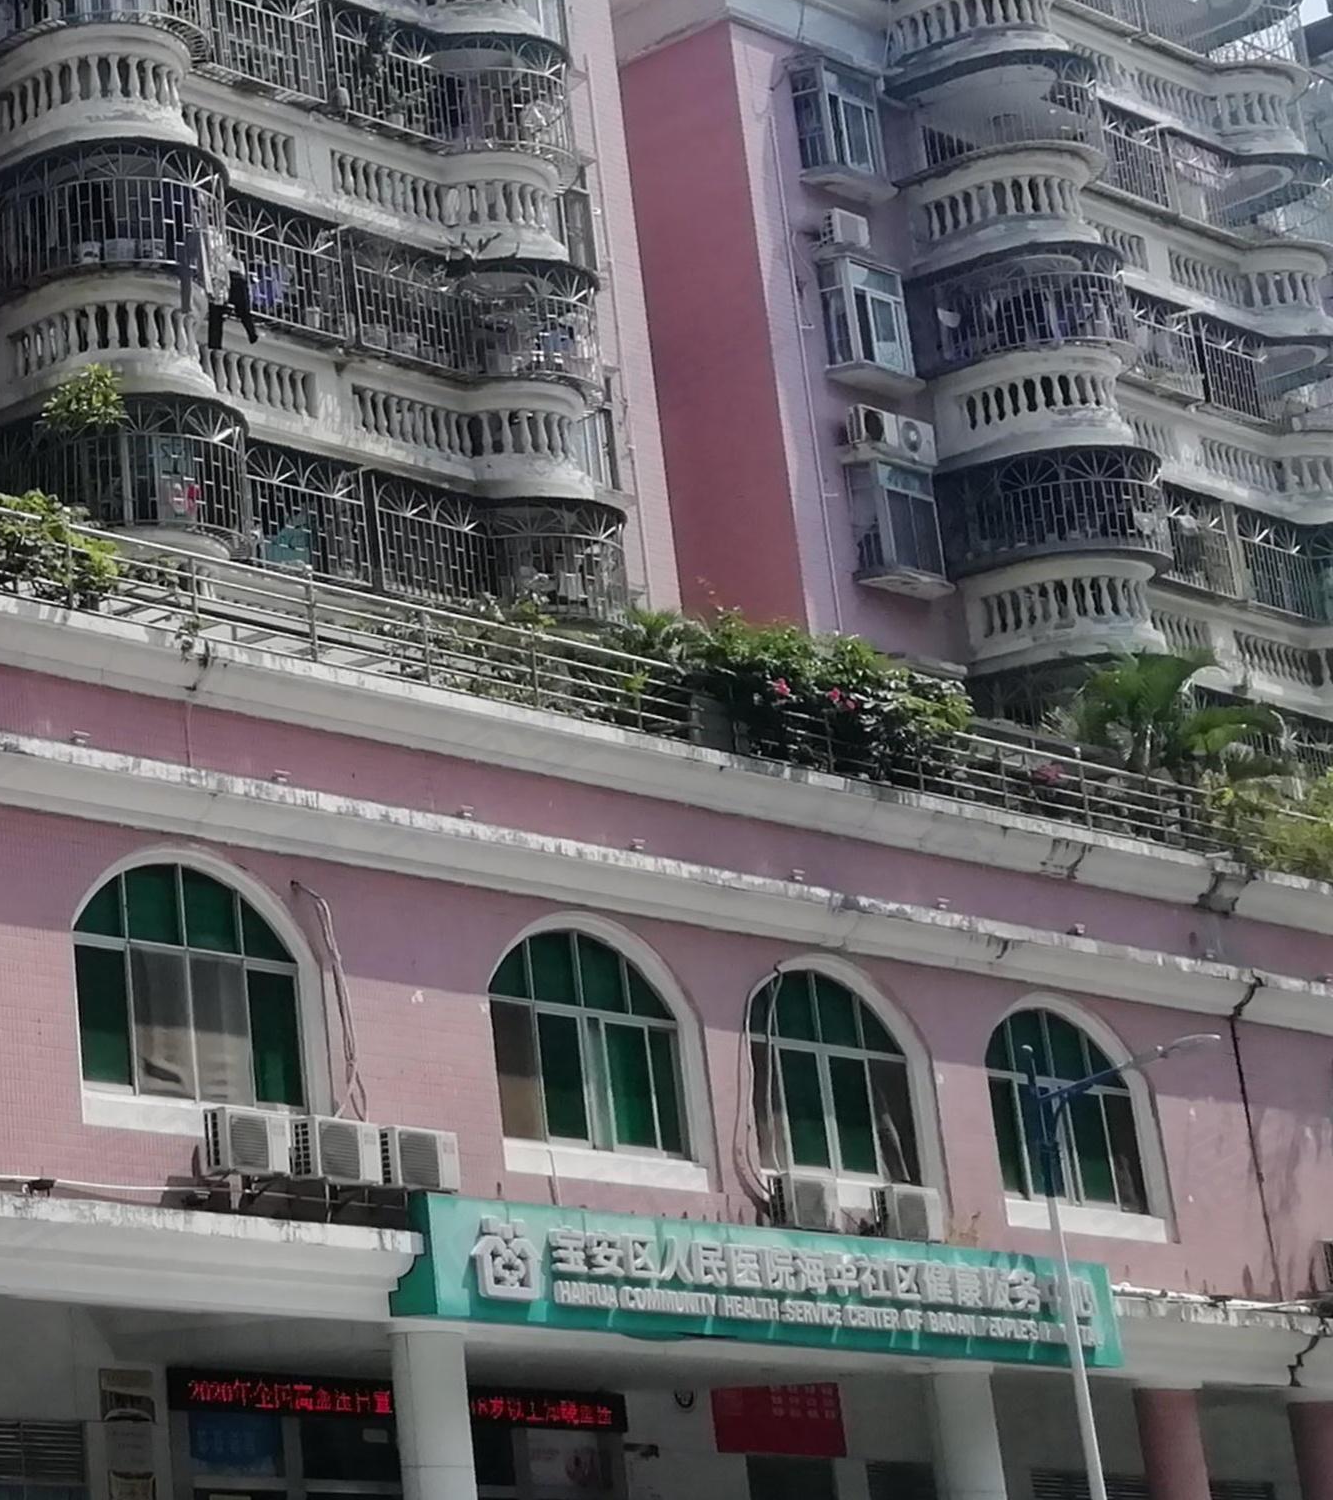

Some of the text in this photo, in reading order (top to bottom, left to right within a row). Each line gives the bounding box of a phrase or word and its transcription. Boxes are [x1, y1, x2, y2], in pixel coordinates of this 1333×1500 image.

[619, 1286, 717, 1316] COMMUNITY
[721, 1295, 780, 1321] HEALTH
[781, 1299, 843, 1326] SERVICE
[843, 1305, 901, 1330] CENTER
[901, 1309, 924, 1332] OF
